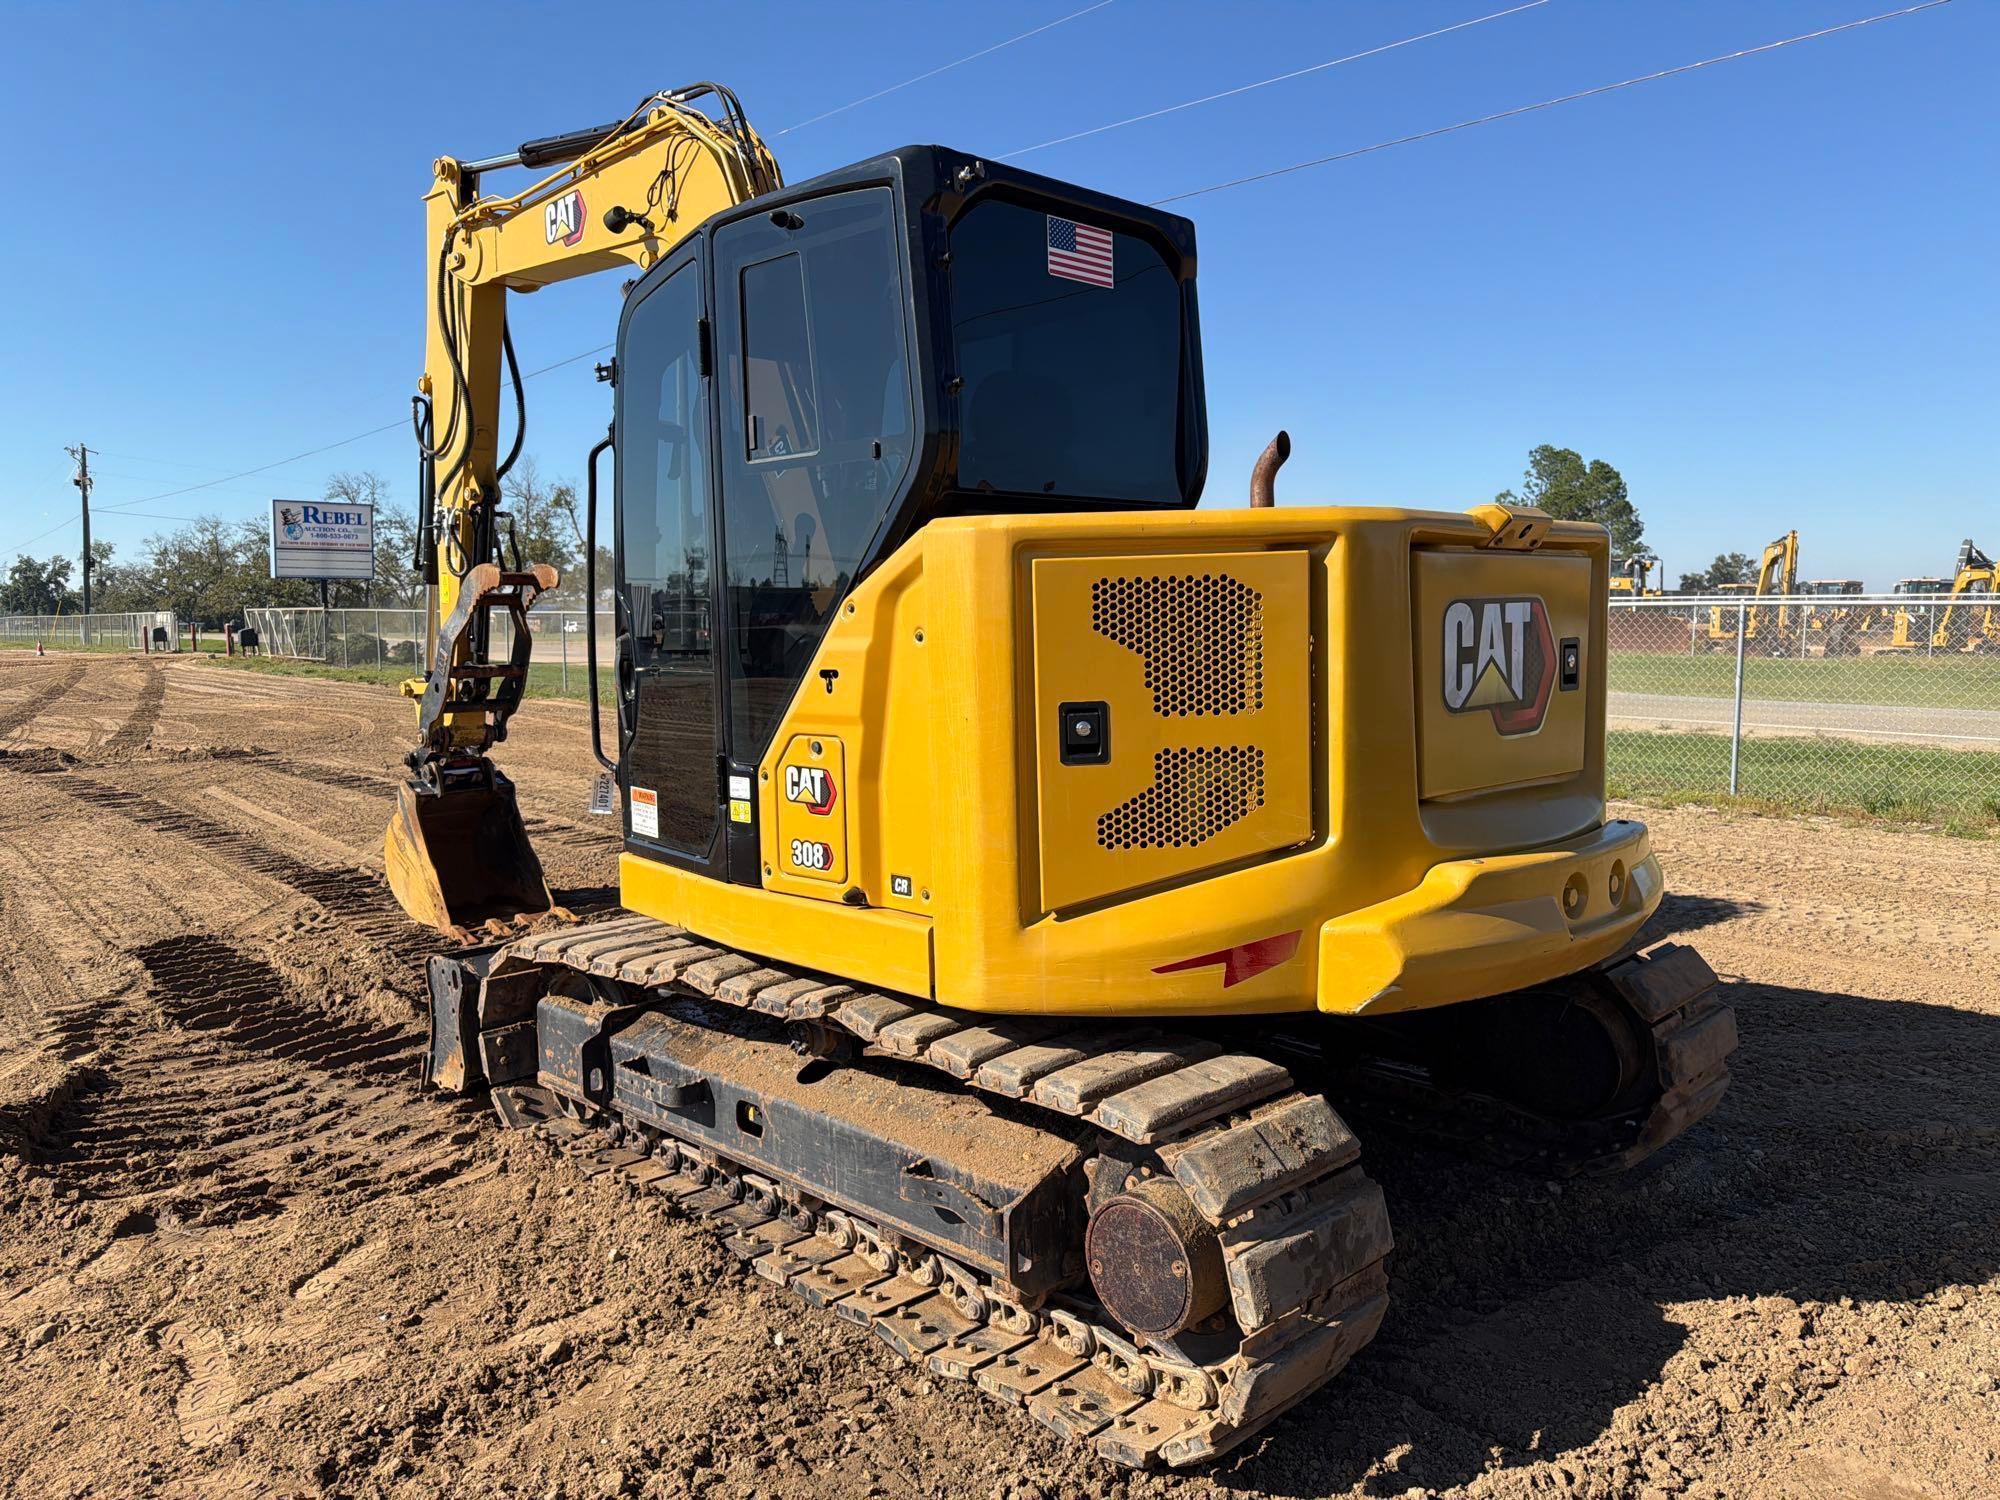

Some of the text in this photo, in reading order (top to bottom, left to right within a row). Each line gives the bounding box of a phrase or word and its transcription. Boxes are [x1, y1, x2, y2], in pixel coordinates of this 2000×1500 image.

[545, 192, 576, 243] CAT
[301, 505, 368, 526] REBEL
[1444, 602, 1531, 709] CAT
[598, 779, 609, 808] 227401
[785, 766, 825, 804] CAT
[792, 840, 824, 869] 308
[894, 878, 908, 894] CR
